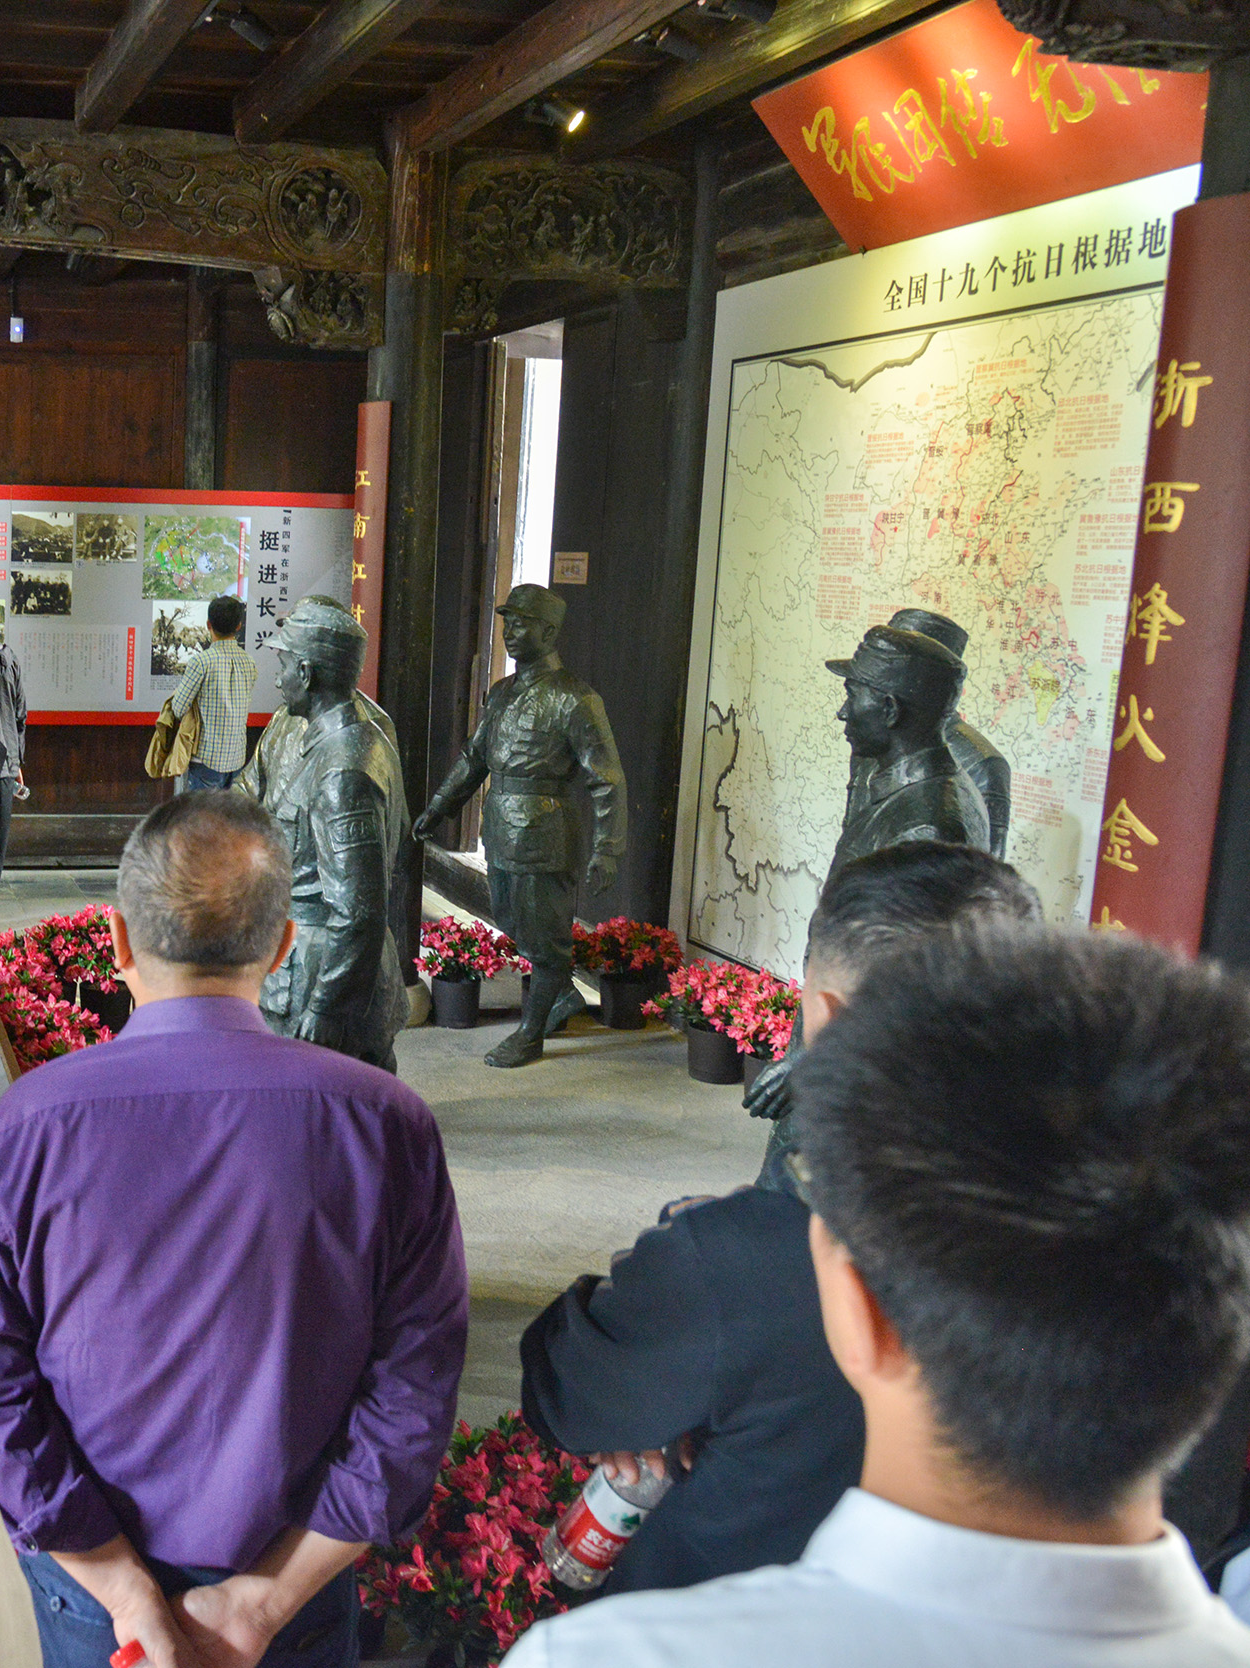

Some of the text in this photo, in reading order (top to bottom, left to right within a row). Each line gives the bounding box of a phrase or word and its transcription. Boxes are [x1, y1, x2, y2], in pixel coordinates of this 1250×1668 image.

[882, 217, 1168, 313] 全国十九个抗日根据地
[1110, 465, 1144, 476] 山东抗日
[1004, 531, 1031, 544] 山东
[255, 530, 280, 651] 挺进长兴
[1074, 563, 1127, 575] 苏北抗日根据地
[1092, 358, 1214, 933] 浙西烽火金
